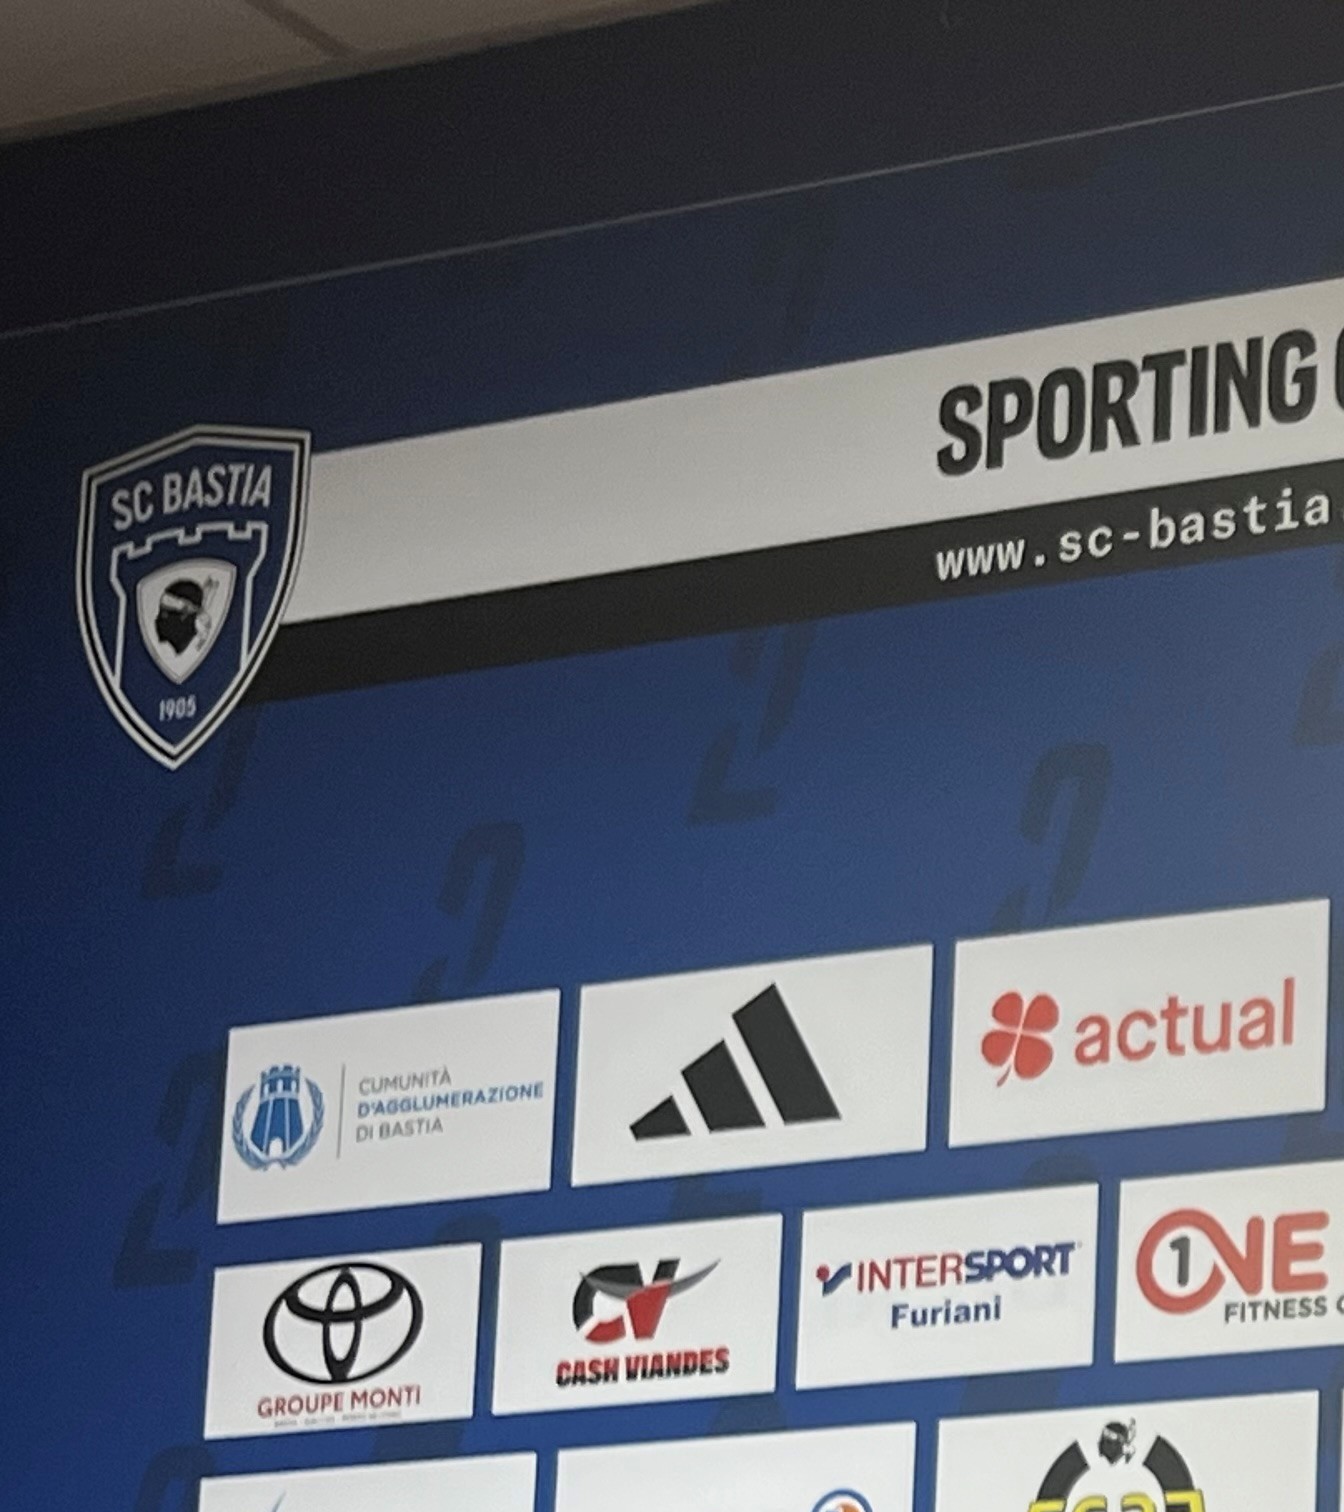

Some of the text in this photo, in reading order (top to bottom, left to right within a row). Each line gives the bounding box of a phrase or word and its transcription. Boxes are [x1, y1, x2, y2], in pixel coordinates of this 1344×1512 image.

[936, 328, 1317, 477] SPORTING
[111, 464, 272, 531] SC BASTIA
[158, 697, 197, 721] 1905
[1073, 977, 1295, 1066] actual
[358, 1065, 452, 1095] CUMUNITÀ
[357, 1082, 545, 1118] D'AGGLUMERAZIONE
[356, 1117, 444, 1143] DI BASTIA
[857, 1241, 1075, 1293] INTERSPORT
[891, 1296, 1002, 1329] Furiani
[1223, 1299, 1328, 1324] FITNESS
[556, 1347, 731, 1387] CASH VIANDES
[257, 1384, 421, 1418] GROUPE MONTI
